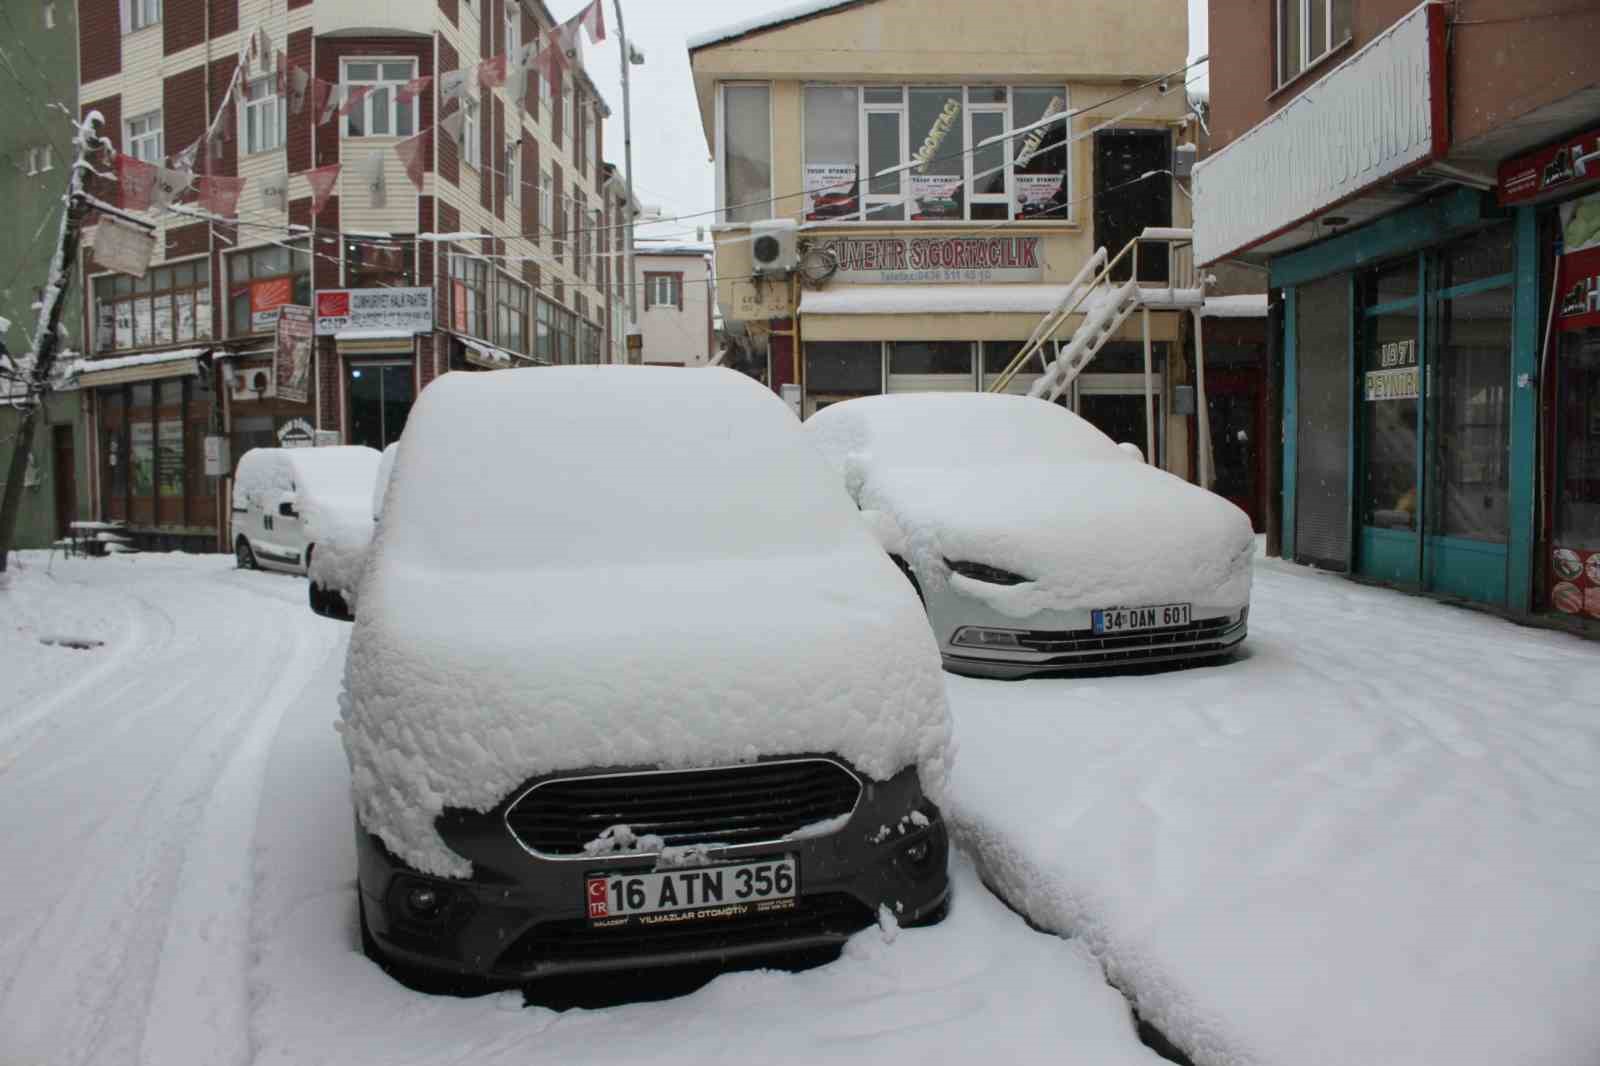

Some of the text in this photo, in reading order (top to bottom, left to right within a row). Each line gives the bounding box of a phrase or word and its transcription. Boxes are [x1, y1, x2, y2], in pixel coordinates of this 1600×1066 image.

[1104, 606, 1188, 630] 34 DAN 601
[591, 902, 608, 914] TR
[610, 878, 646, 912] 16
[658, 871, 723, 908] ATN
[735, 863, 793, 898] 356
[639, 911, 695, 925] YILMAZLAR
